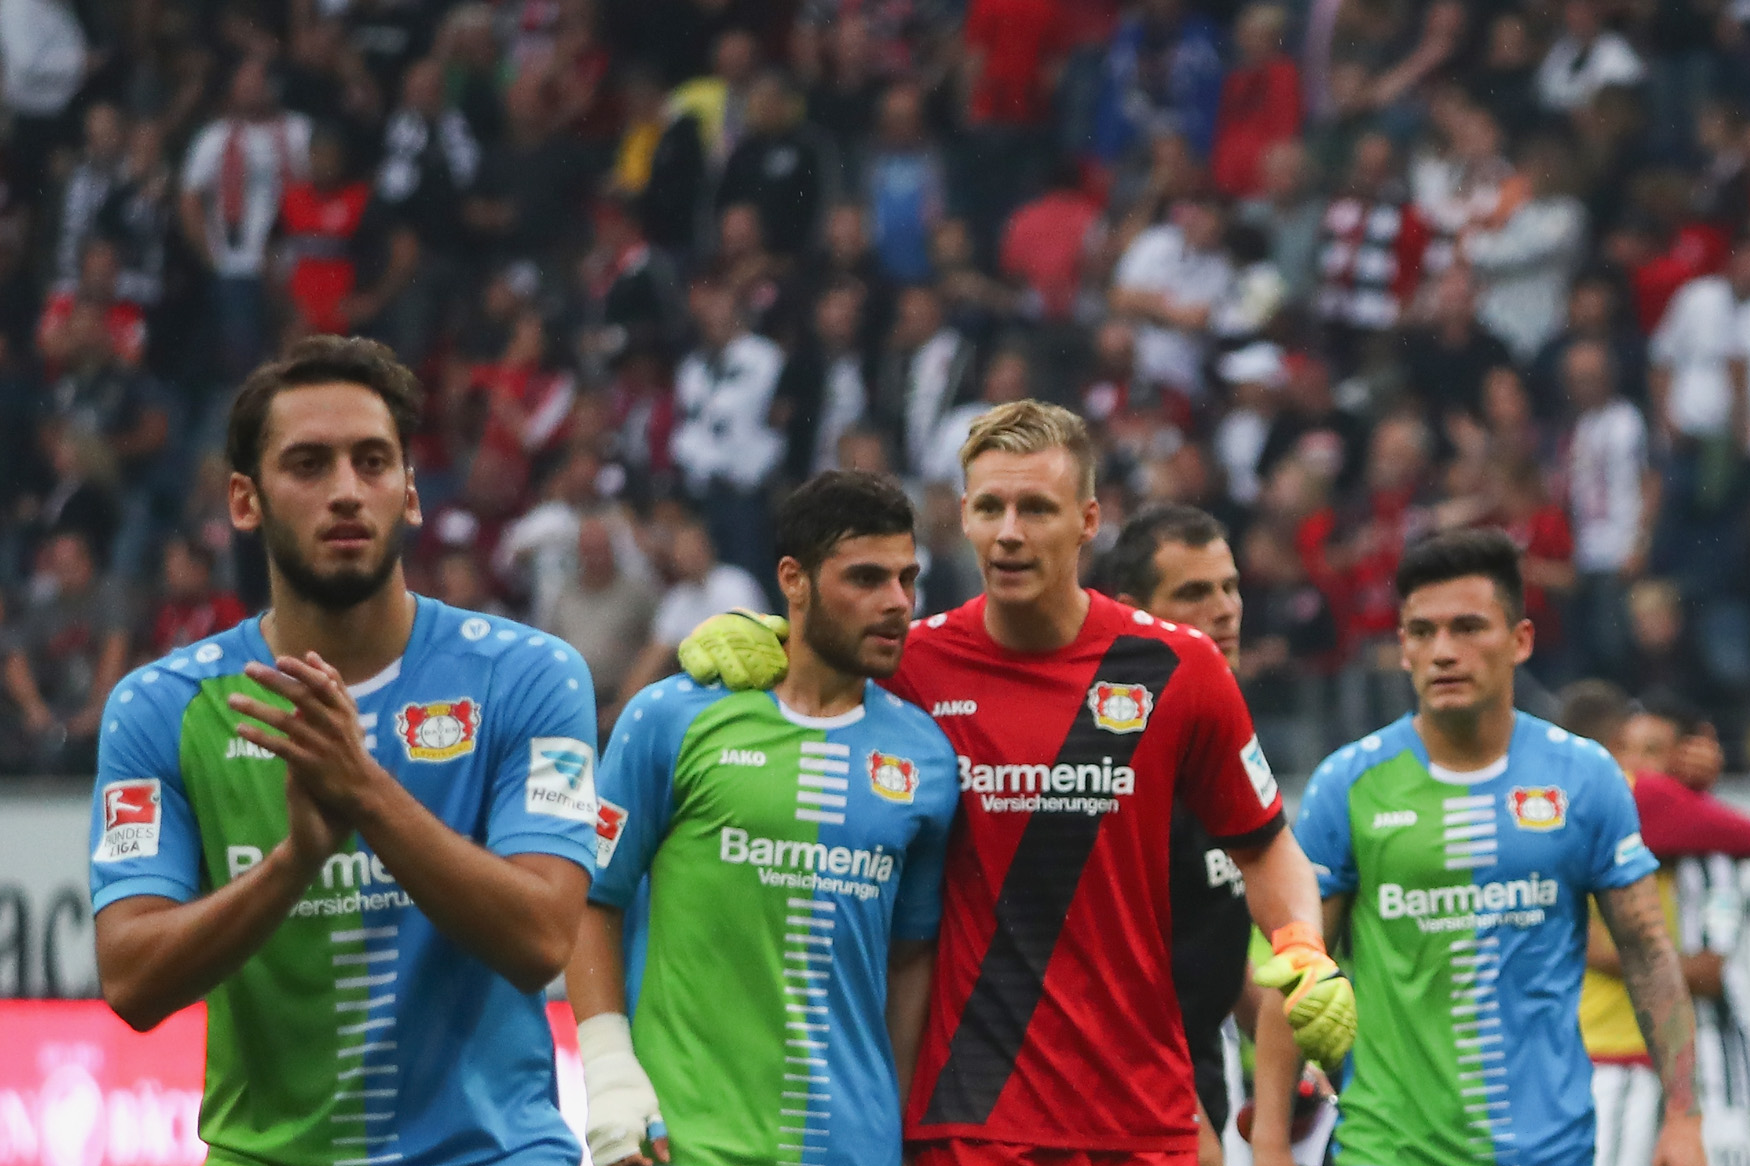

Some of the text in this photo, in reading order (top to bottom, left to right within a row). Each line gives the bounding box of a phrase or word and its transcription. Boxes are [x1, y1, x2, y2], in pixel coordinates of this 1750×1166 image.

[932, 699, 978, 718] JAKO
[226, 737, 276, 760] JAK
[719, 749, 767, 768] JAKO
[957, 754, 1136, 797] Barmenia
[531, 786, 595, 813] Hermes
[980, 794, 1120, 818] Versicherungen
[1372, 809, 1418, 830] JAKO
[110, 841, 140, 857] LIGA
[720, 825, 895, 883] Barmenia
[1378, 871, 1559, 920] Barmenia
